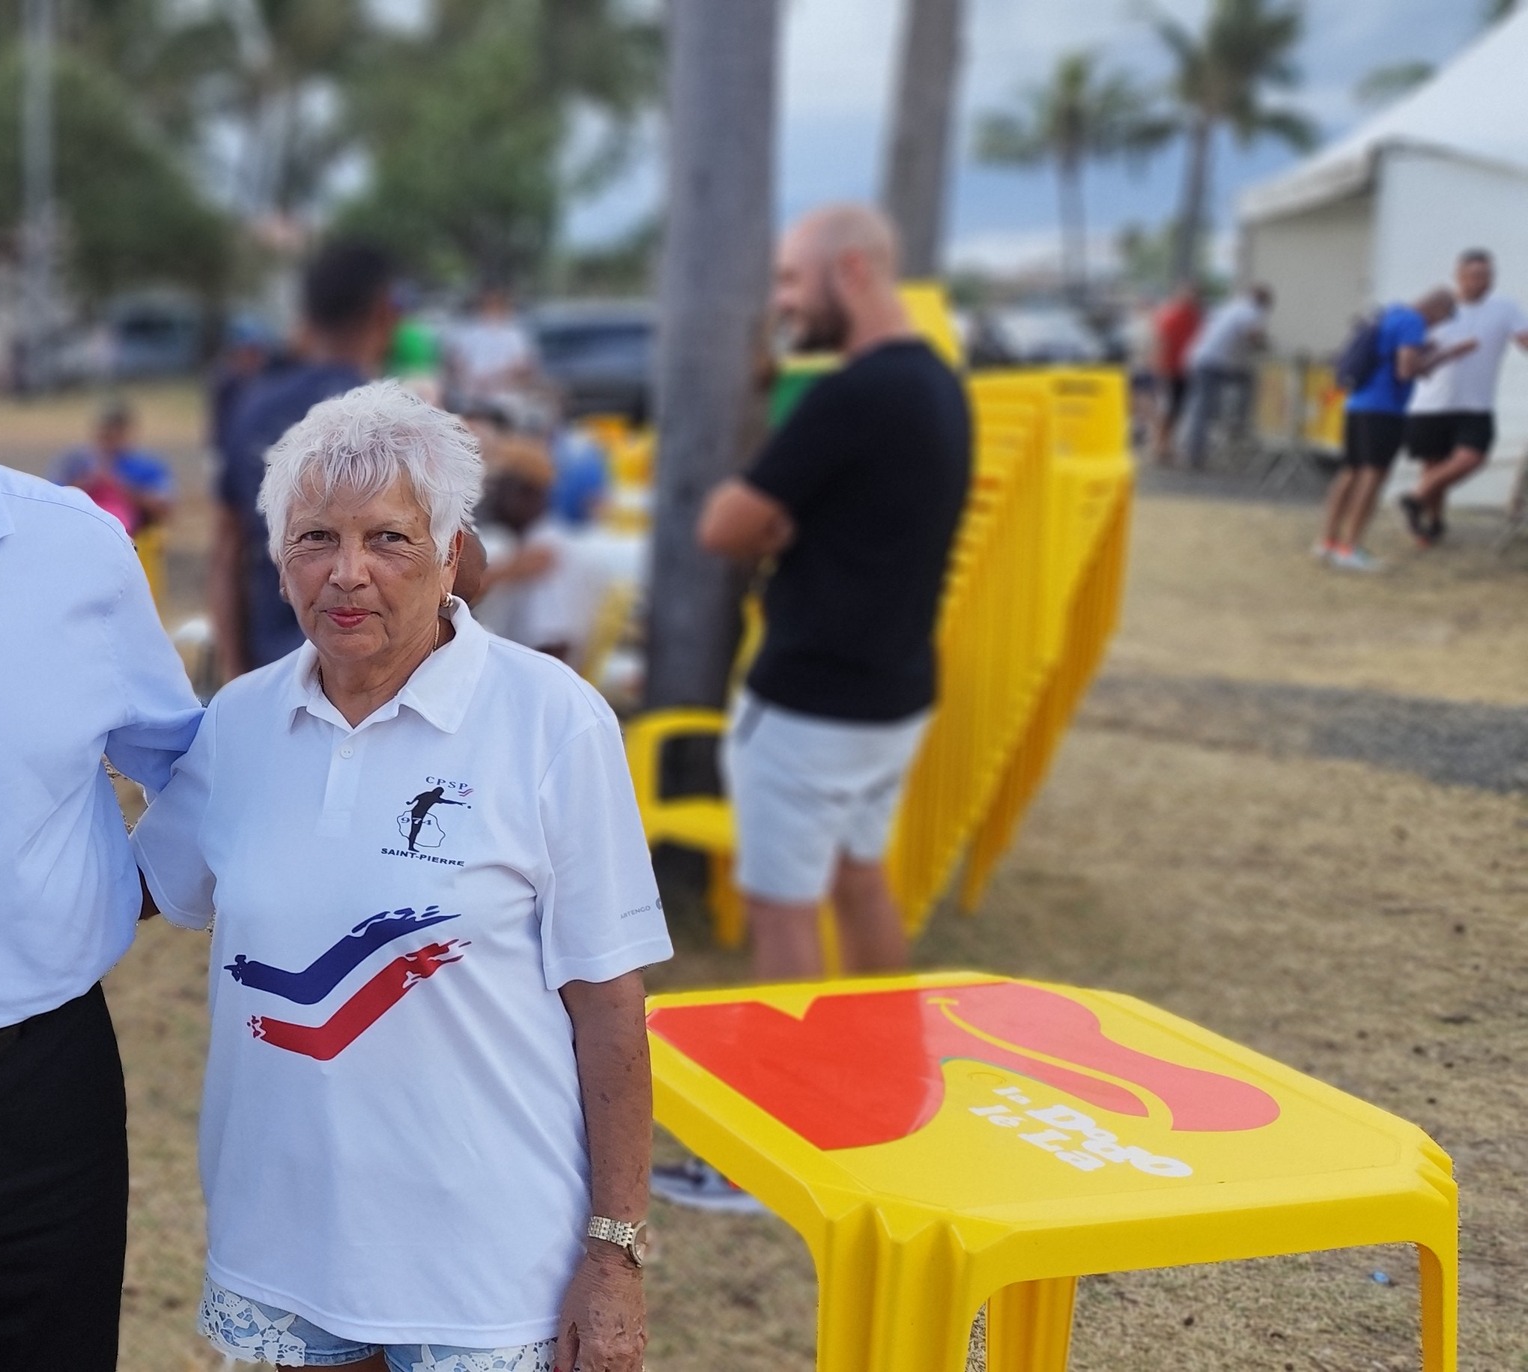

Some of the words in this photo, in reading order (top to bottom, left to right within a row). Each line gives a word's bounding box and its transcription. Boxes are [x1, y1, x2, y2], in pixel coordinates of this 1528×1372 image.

[425, 776, 469, 790] CPSP
[401, 816, 432, 826] 974
[380, 848, 465, 867] SAINT-PIERRE
[1017, 1129, 1106, 1171] La
[1024, 1104, 1193, 1178] Dodo
